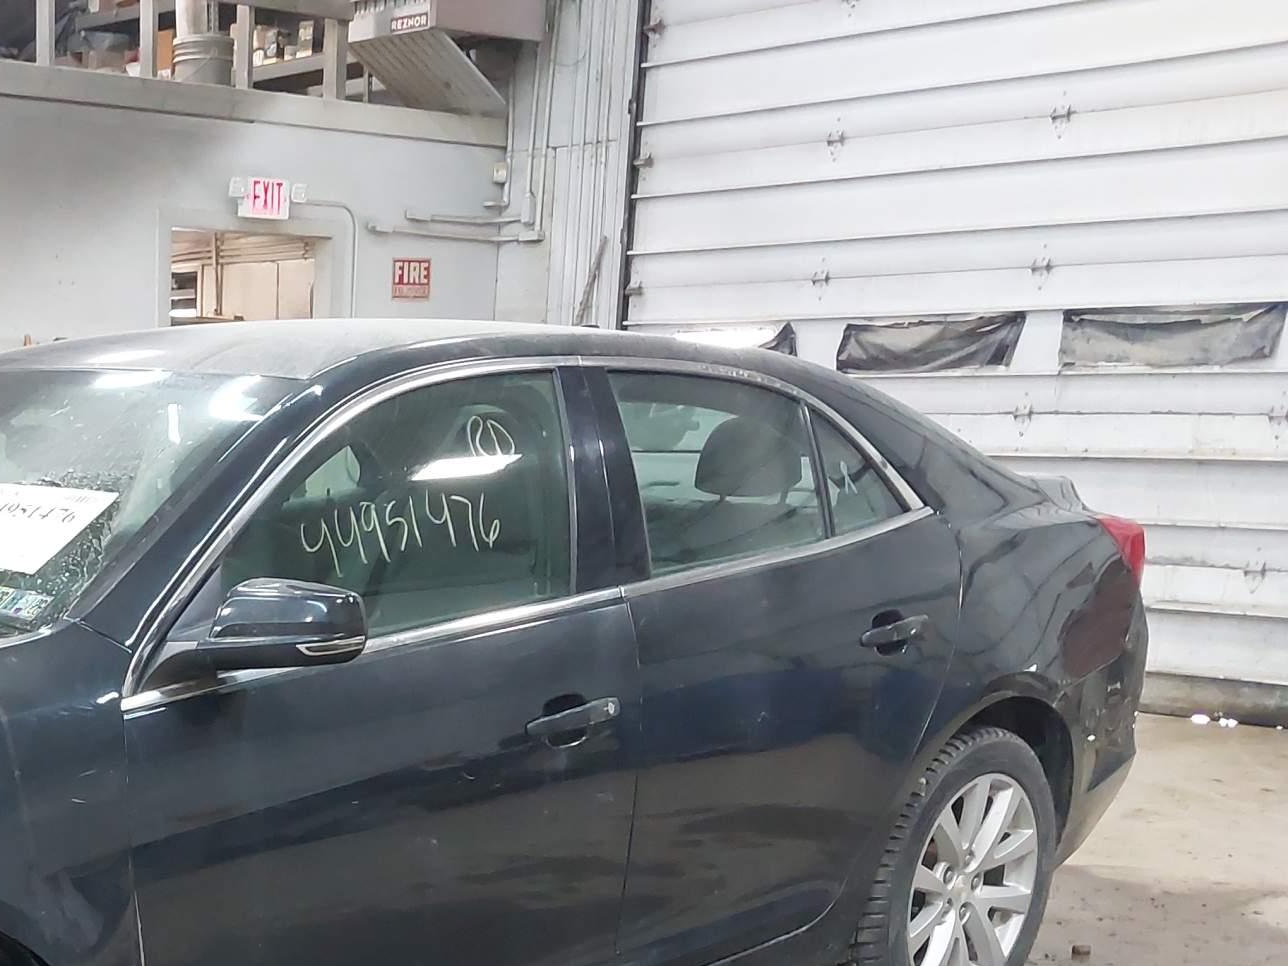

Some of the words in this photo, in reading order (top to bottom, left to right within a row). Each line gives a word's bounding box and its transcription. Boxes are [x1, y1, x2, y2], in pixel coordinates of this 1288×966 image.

[391, 14, 427, 31] REZNOR
[252, 180, 284, 215] EXIT
[394, 261, 430, 284] FIRE
[300, 487, 501, 578] 44951476
